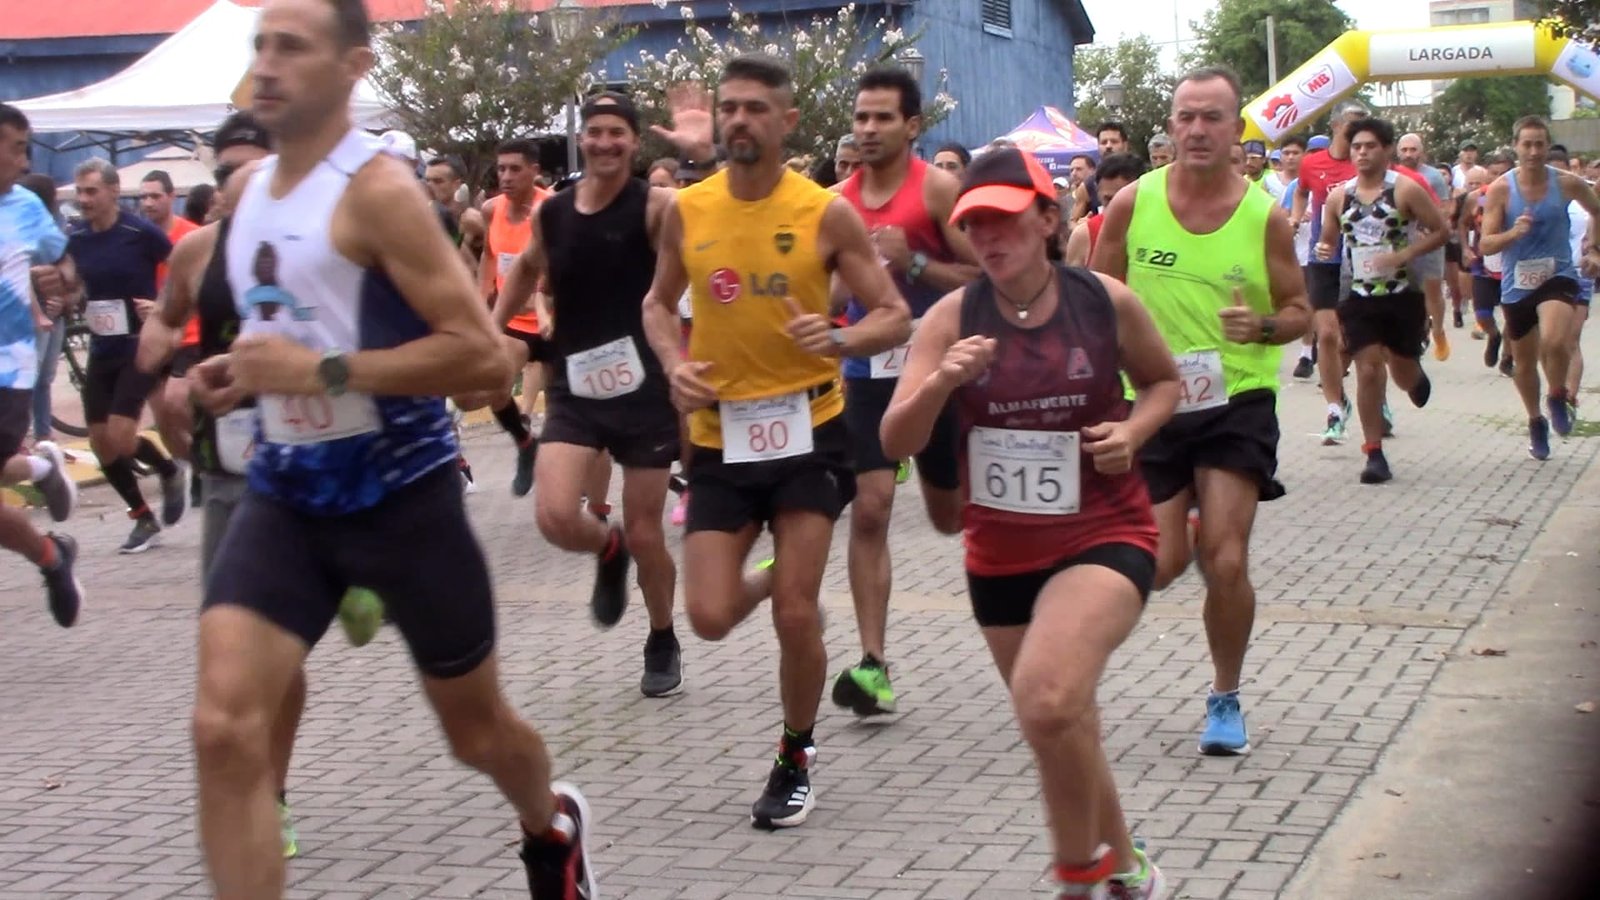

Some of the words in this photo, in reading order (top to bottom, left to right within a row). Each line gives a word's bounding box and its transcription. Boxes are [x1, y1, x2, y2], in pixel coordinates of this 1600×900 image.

[1409, 46, 1493, 61] LARGADA
[1307, 73, 1330, 93] MB
[749, 272, 788, 297] LG
[583, 361, 633, 395] 105
[1179, 375, 1214, 404] 42
[988, 394, 1088, 415] ALMAFUERTE
[748, 420, 788, 453] 80
[985, 461, 1063, 504] 615
